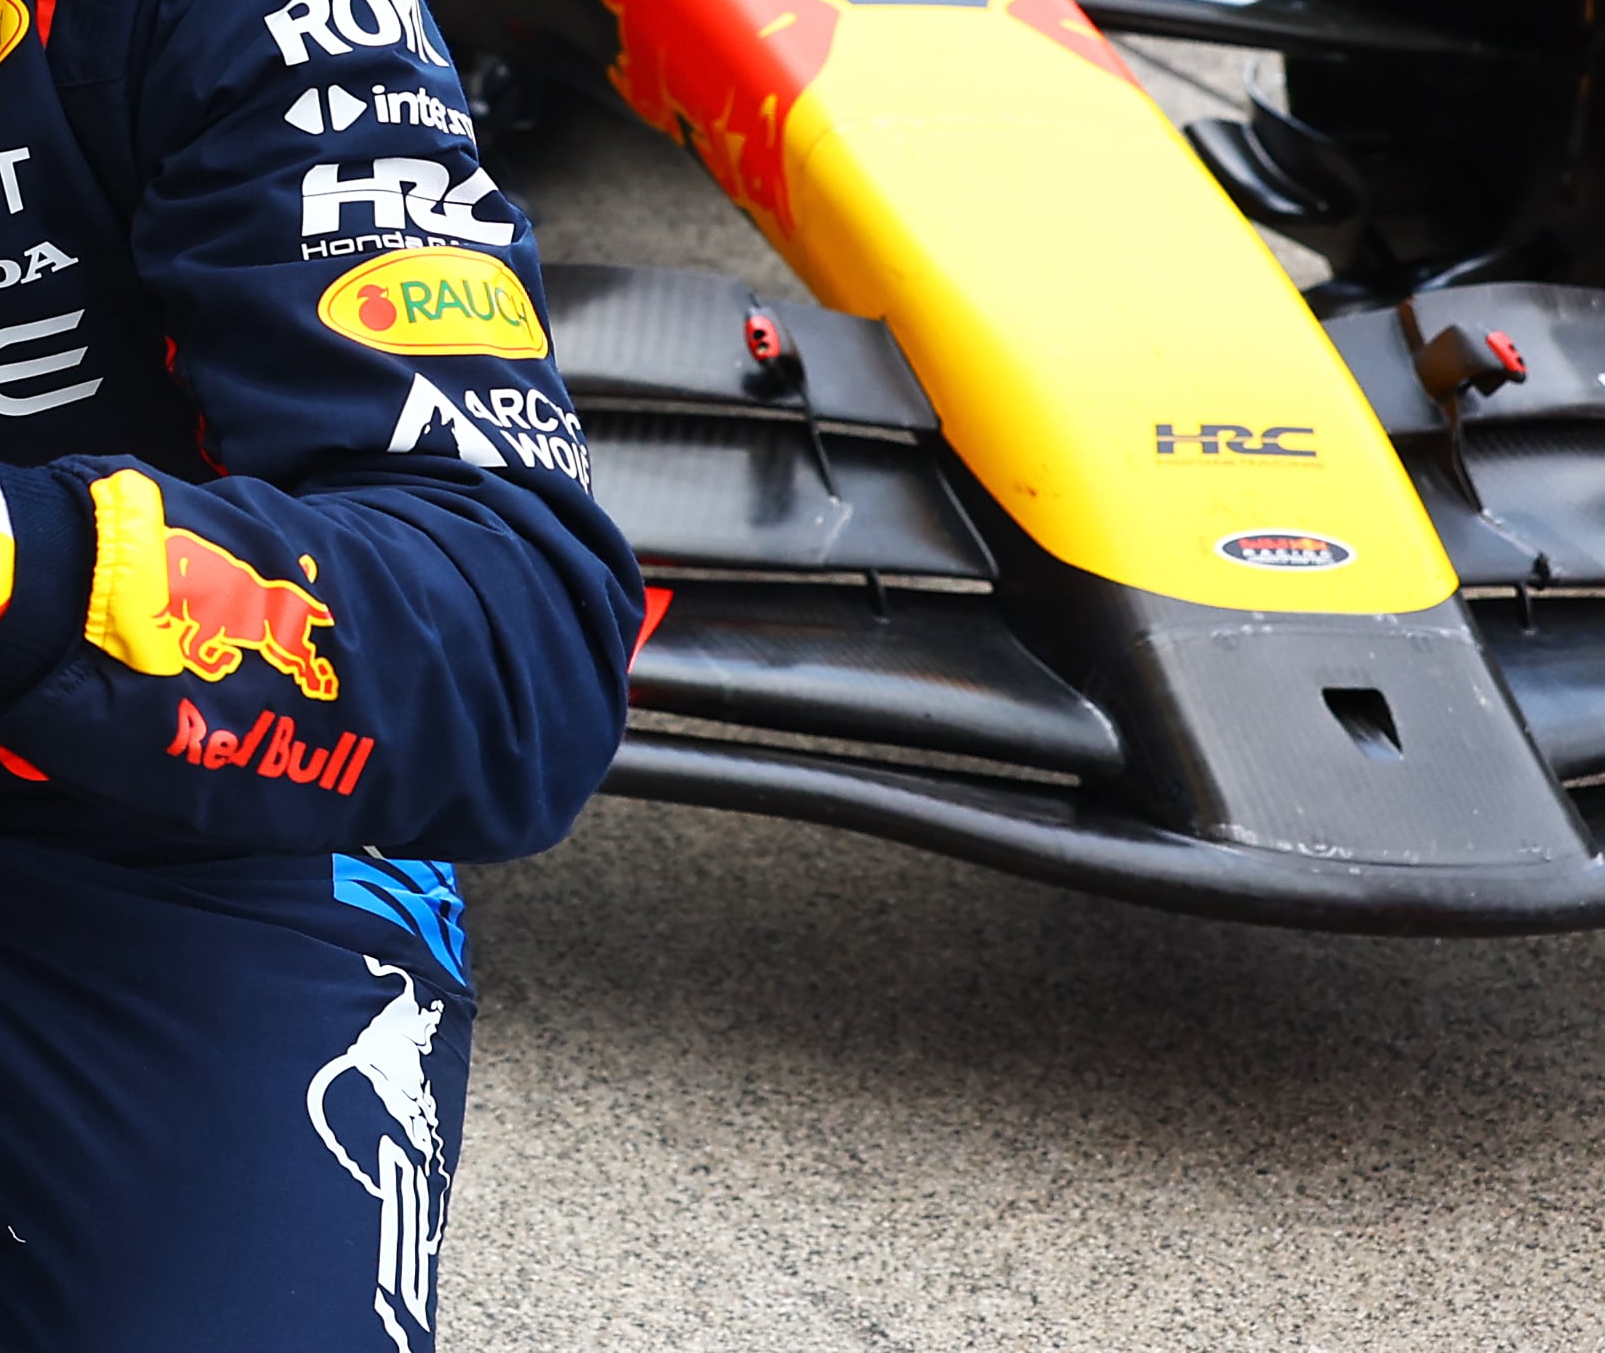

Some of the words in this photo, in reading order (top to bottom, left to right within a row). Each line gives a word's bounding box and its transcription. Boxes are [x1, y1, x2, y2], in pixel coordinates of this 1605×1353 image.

[301, 157, 515, 246] HRC
[1155, 423, 1318, 458] HRC
[166, 698, 276, 771] Red
[255, 710, 375, 796] Bull
